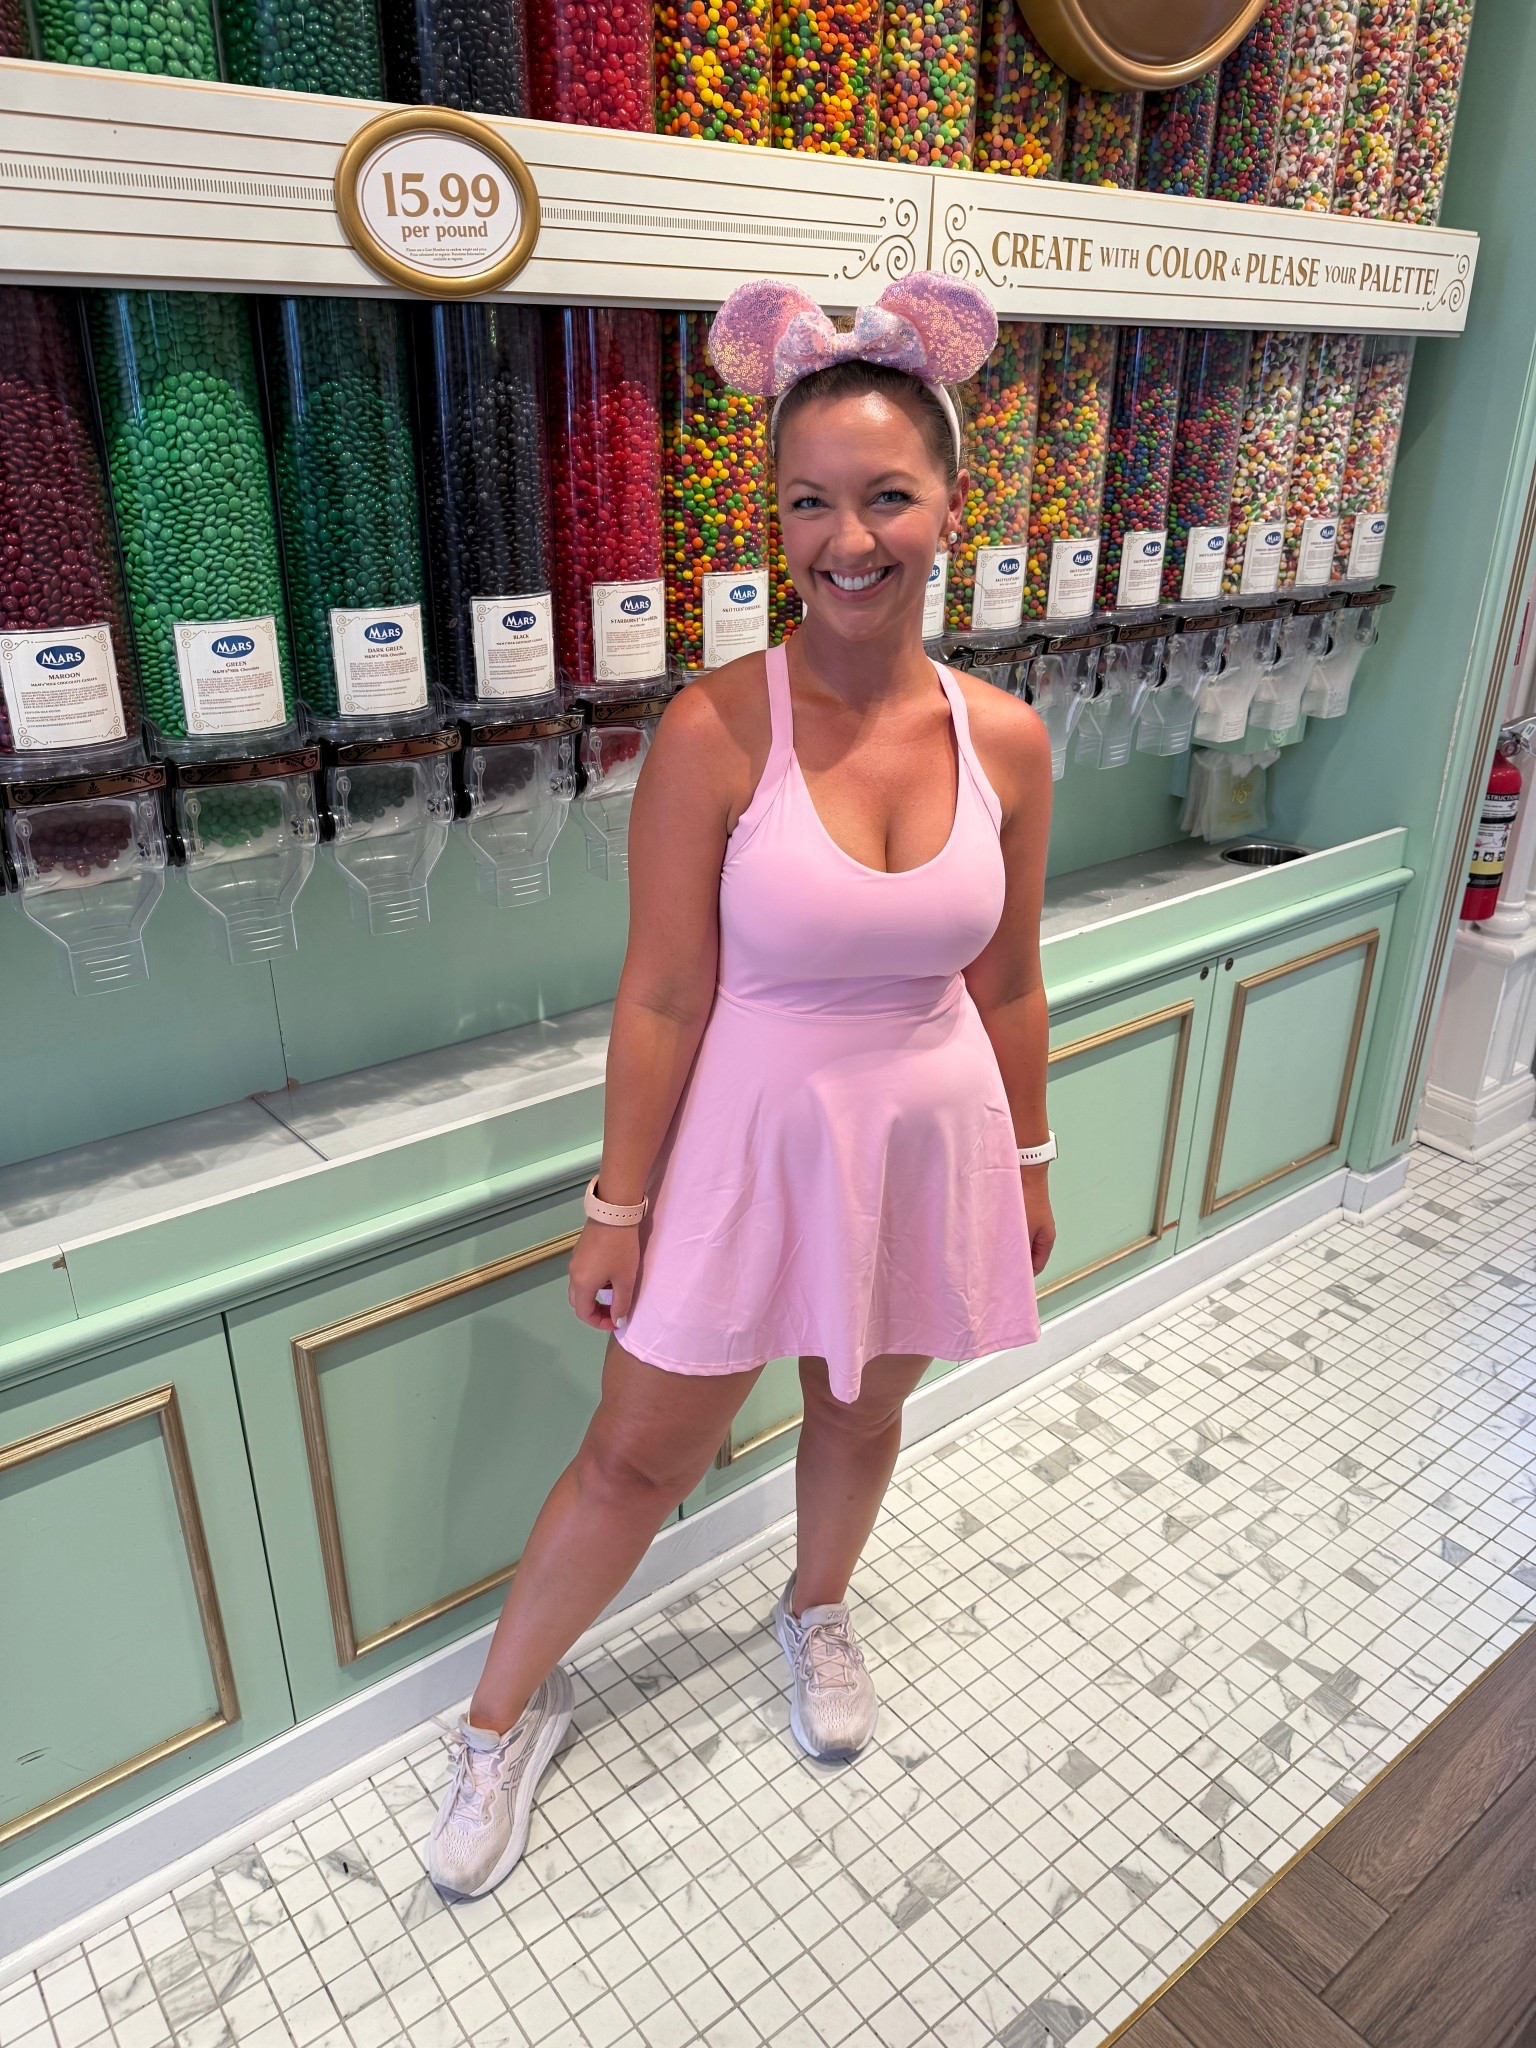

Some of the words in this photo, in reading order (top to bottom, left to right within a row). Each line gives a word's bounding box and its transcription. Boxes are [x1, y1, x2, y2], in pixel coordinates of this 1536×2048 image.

[382, 172, 500, 218] 15.99
[401, 225, 430, 242] per
[436, 221, 488, 241] pound
[991, 231, 1094, 272] CREATE
[1099, 246, 1140, 269] WITH
[1146, 244, 1228, 282] COLOR
[1231, 257, 1241, 276] &
[1245, 253, 1320, 287] PLEASE
[1325, 265, 1357, 285] YOUR
[1359, 262, 1440, 296] PALETTE!
[1145, 544, 1161, 554] MARS
[1074, 553, 1092, 563] MARS
[1001, 561, 1019, 572] MARS
[732, 589, 756, 601] MARS
[623, 599, 650, 612] MARS
[506, 615, 534, 628] MARS
[368, 626, 401, 640] MARS
[216, 640, 252, 655] MARS
[41, 651, 82, 666] MARS
[48, 672, 81, 680] MAROON
